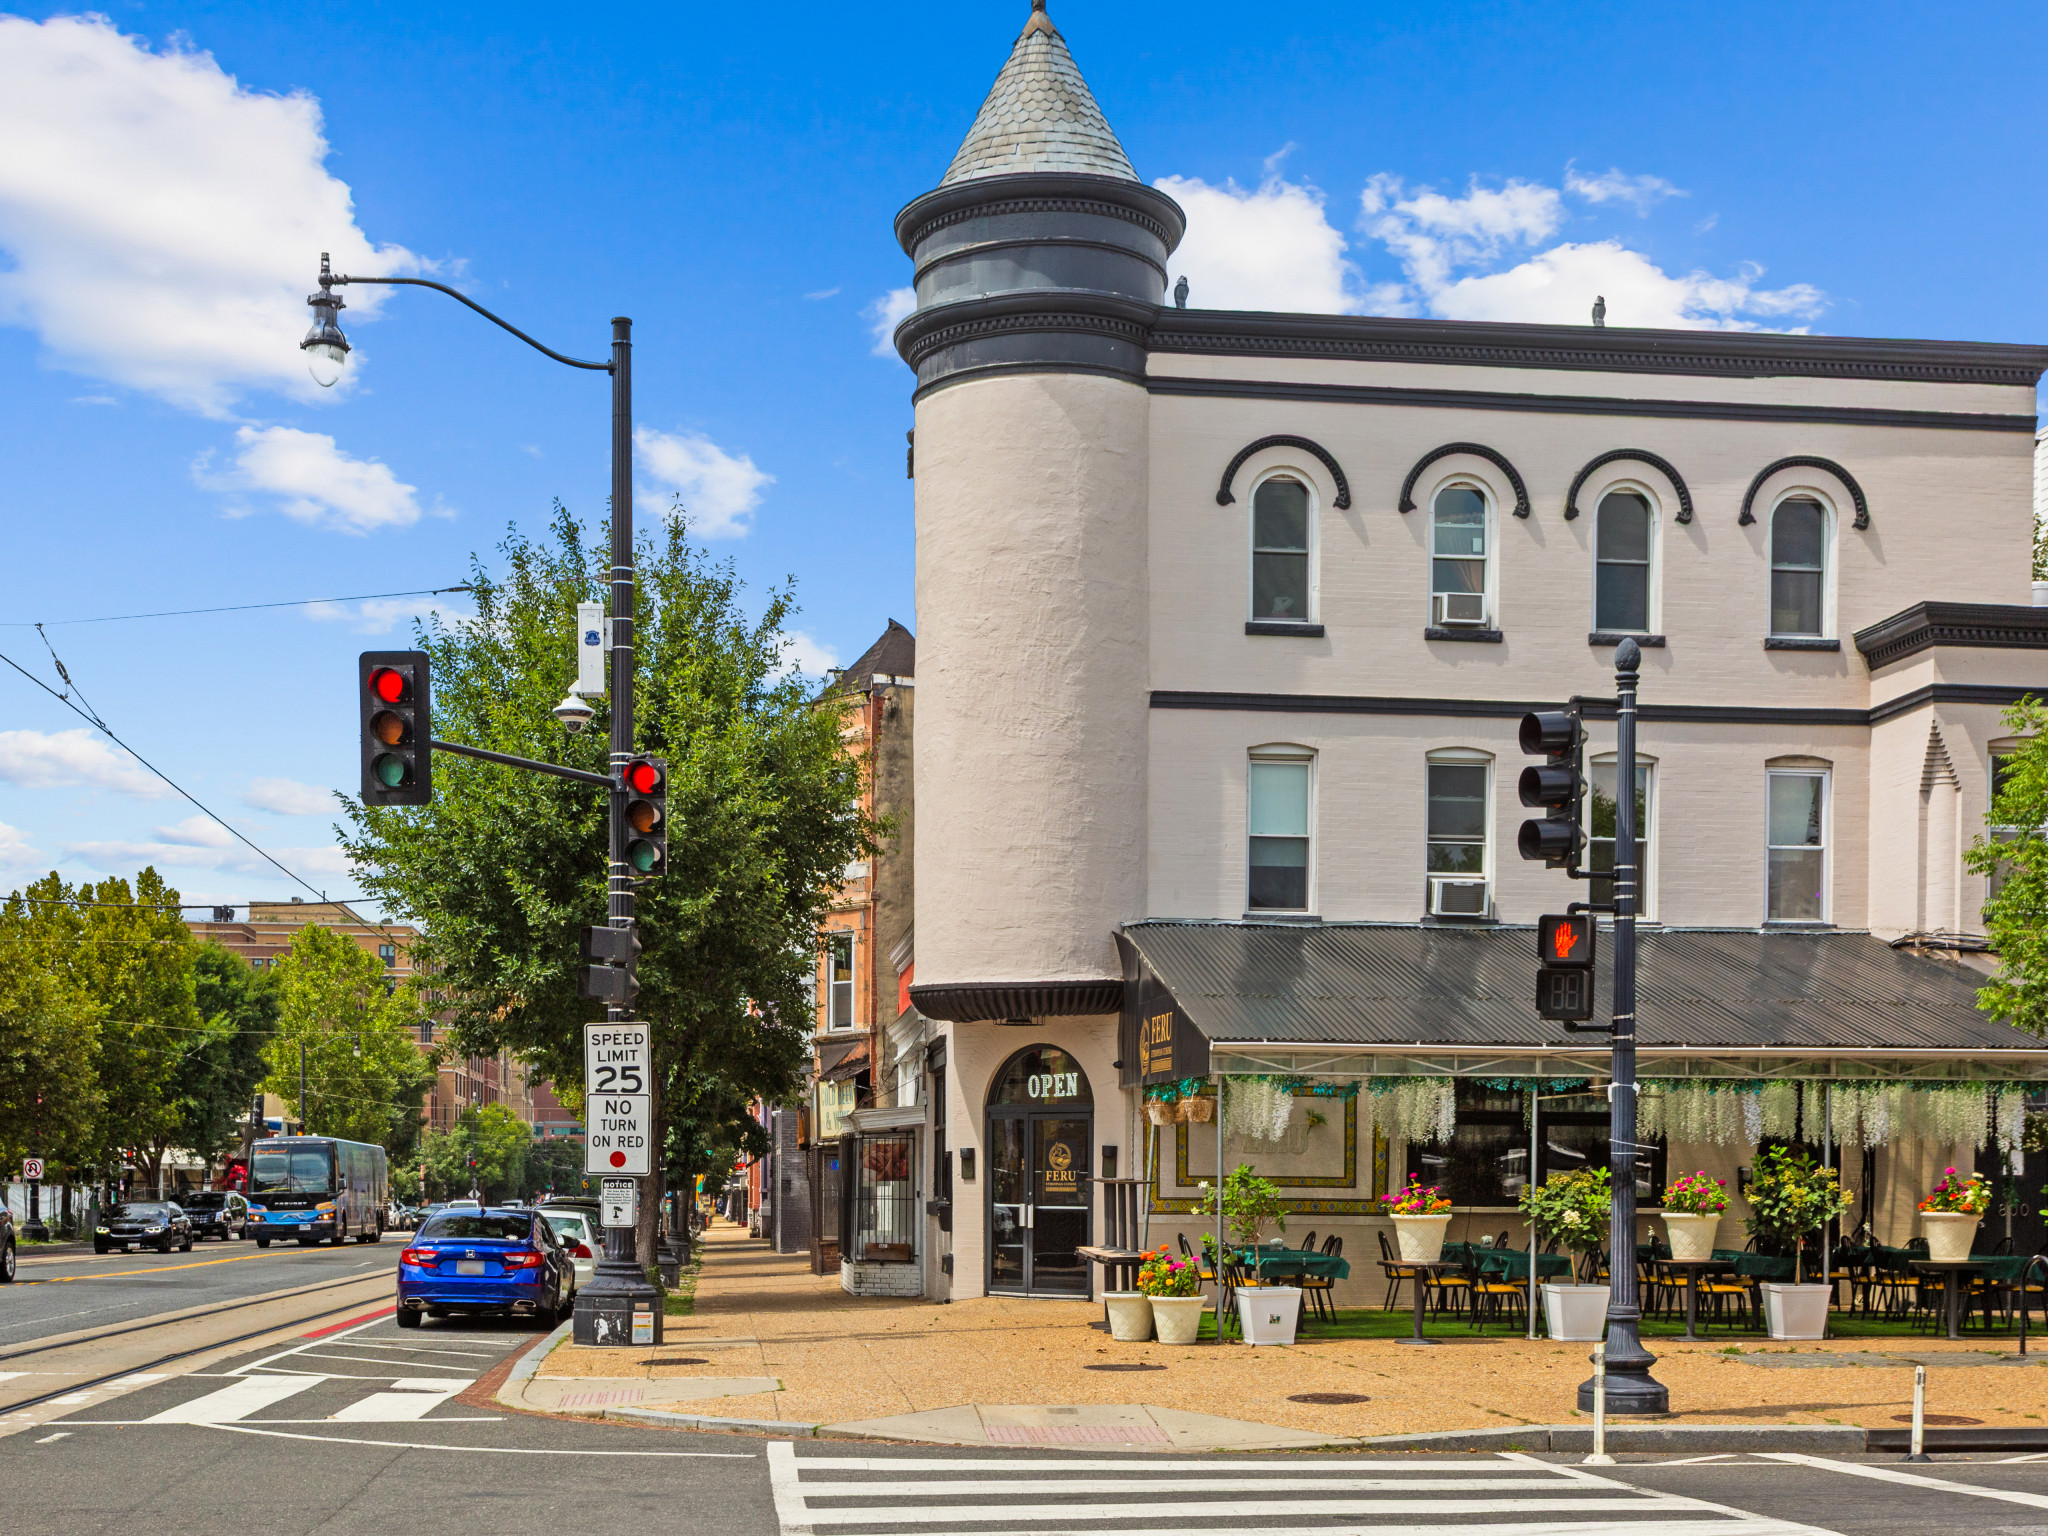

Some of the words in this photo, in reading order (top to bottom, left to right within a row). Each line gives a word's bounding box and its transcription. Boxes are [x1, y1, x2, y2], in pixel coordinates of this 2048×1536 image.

[1151, 1011, 1173, 1045] FERU
[591, 1033, 644, 1045] SPEED
[597, 1049, 638, 1062] LIMIT
[594, 1065, 642, 1094] 25
[1028, 1072, 1078, 1098] OPEN
[605, 1100, 632, 1115] NO
[600, 1118, 637, 1131] TURN
[592, 1135, 611, 1148] ON
[617, 1135, 644, 1148] RED
[255, 1148, 287, 1156] Greyhound
[1046, 1170, 1076, 1182] FERU
